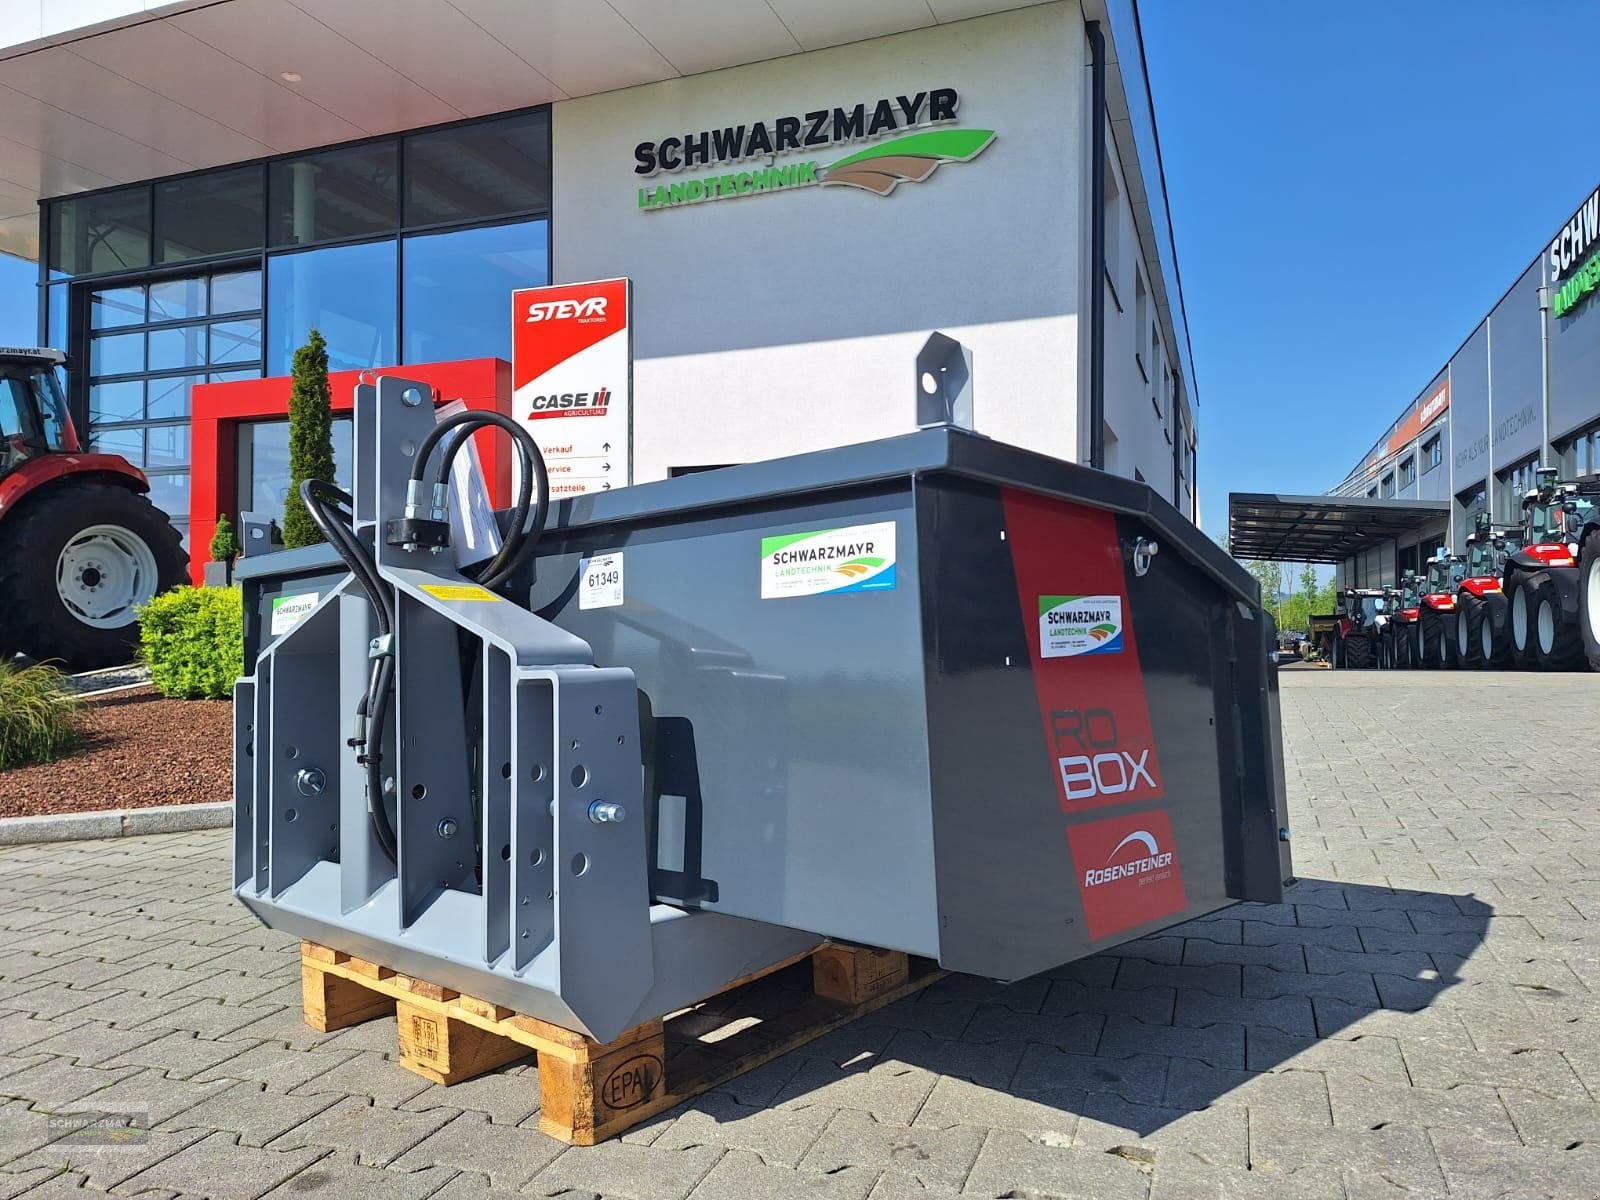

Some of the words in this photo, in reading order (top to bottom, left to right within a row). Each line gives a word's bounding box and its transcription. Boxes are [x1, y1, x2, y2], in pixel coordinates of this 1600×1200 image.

[634, 87, 959, 176] SCHWARZMAYR
[638, 161, 819, 209] LANDTECHNIK
[1551, 189, 1600, 281] SCHW
[526, 297, 608, 323] STEYR
[532, 393, 588, 410] CASE
[563, 408, 606, 417] AGRICULTURE
[543, 444, 573, 454] Verkauf
[546, 466, 571, 474] ervice
[773, 542, 875, 565] SCHWARZMAYR
[588, 570, 619, 588] 61349
[775, 564, 832, 578] LANDTECHNIK
[1047, 610, 1111, 625] SCHWARZMAYR
[1049, 627, 1088, 637] LANDTECHNIK
[1050, 708, 1119, 752] RO
[1058, 749, 1157, 800] BOX
[1084, 852, 1172, 888] ROSENSTEINER
